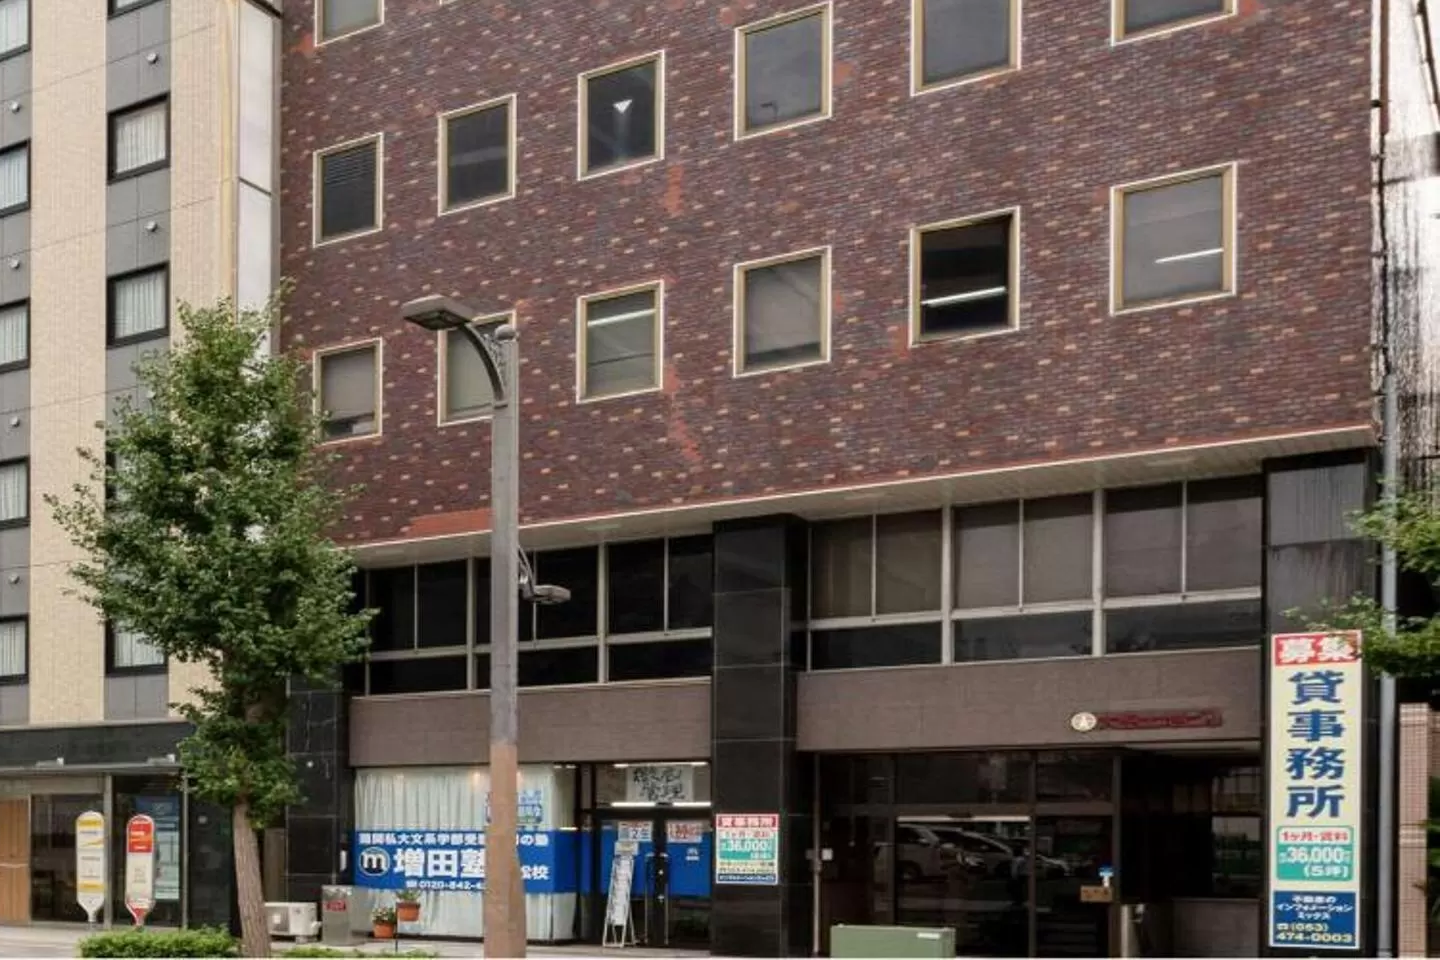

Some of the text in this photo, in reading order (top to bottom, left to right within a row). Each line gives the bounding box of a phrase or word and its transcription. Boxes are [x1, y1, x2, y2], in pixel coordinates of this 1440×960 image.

[1285, 670, 1346, 819] 貸事務所
[393, 848, 485, 878] 増田塾
